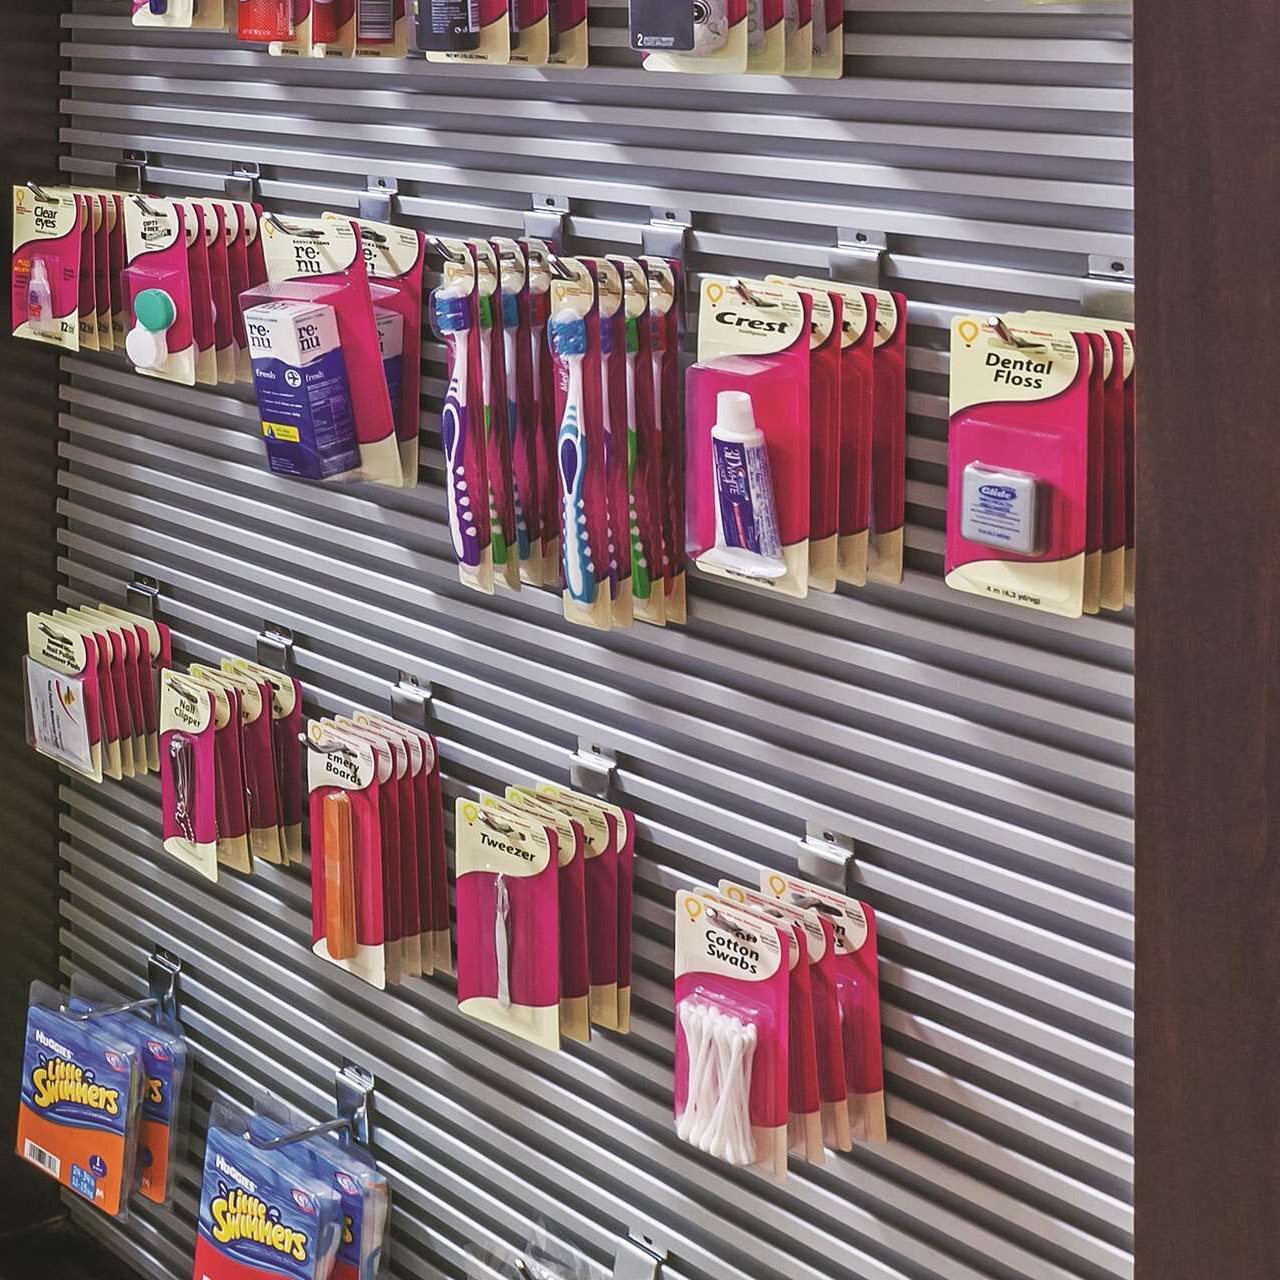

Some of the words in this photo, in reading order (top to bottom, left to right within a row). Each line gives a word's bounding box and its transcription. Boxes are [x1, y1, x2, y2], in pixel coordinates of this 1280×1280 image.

[637, 33, 643, 46] 2
[34, 206, 58, 219] Clear
[34, 218, 57, 229] eyes
[297, 258, 322, 274] nu
[715, 311, 789, 334] Crest
[251, 335, 272, 349] nu
[300, 337, 321, 351] nu
[985, 352, 1053, 376] Dental
[993, 369, 1043, 390] Floss
[179, 699, 196, 712] Nail
[173, 706, 201, 729] Clipper
[325, 761, 362, 787] Boards
[479, 831, 537, 864] Tweezer
[704, 929, 760, 962] Cotton
[706, 943, 758, 975] Swabs
[47, 1057, 83, 1082] Little
[228, 1188, 267, 1218] Little
